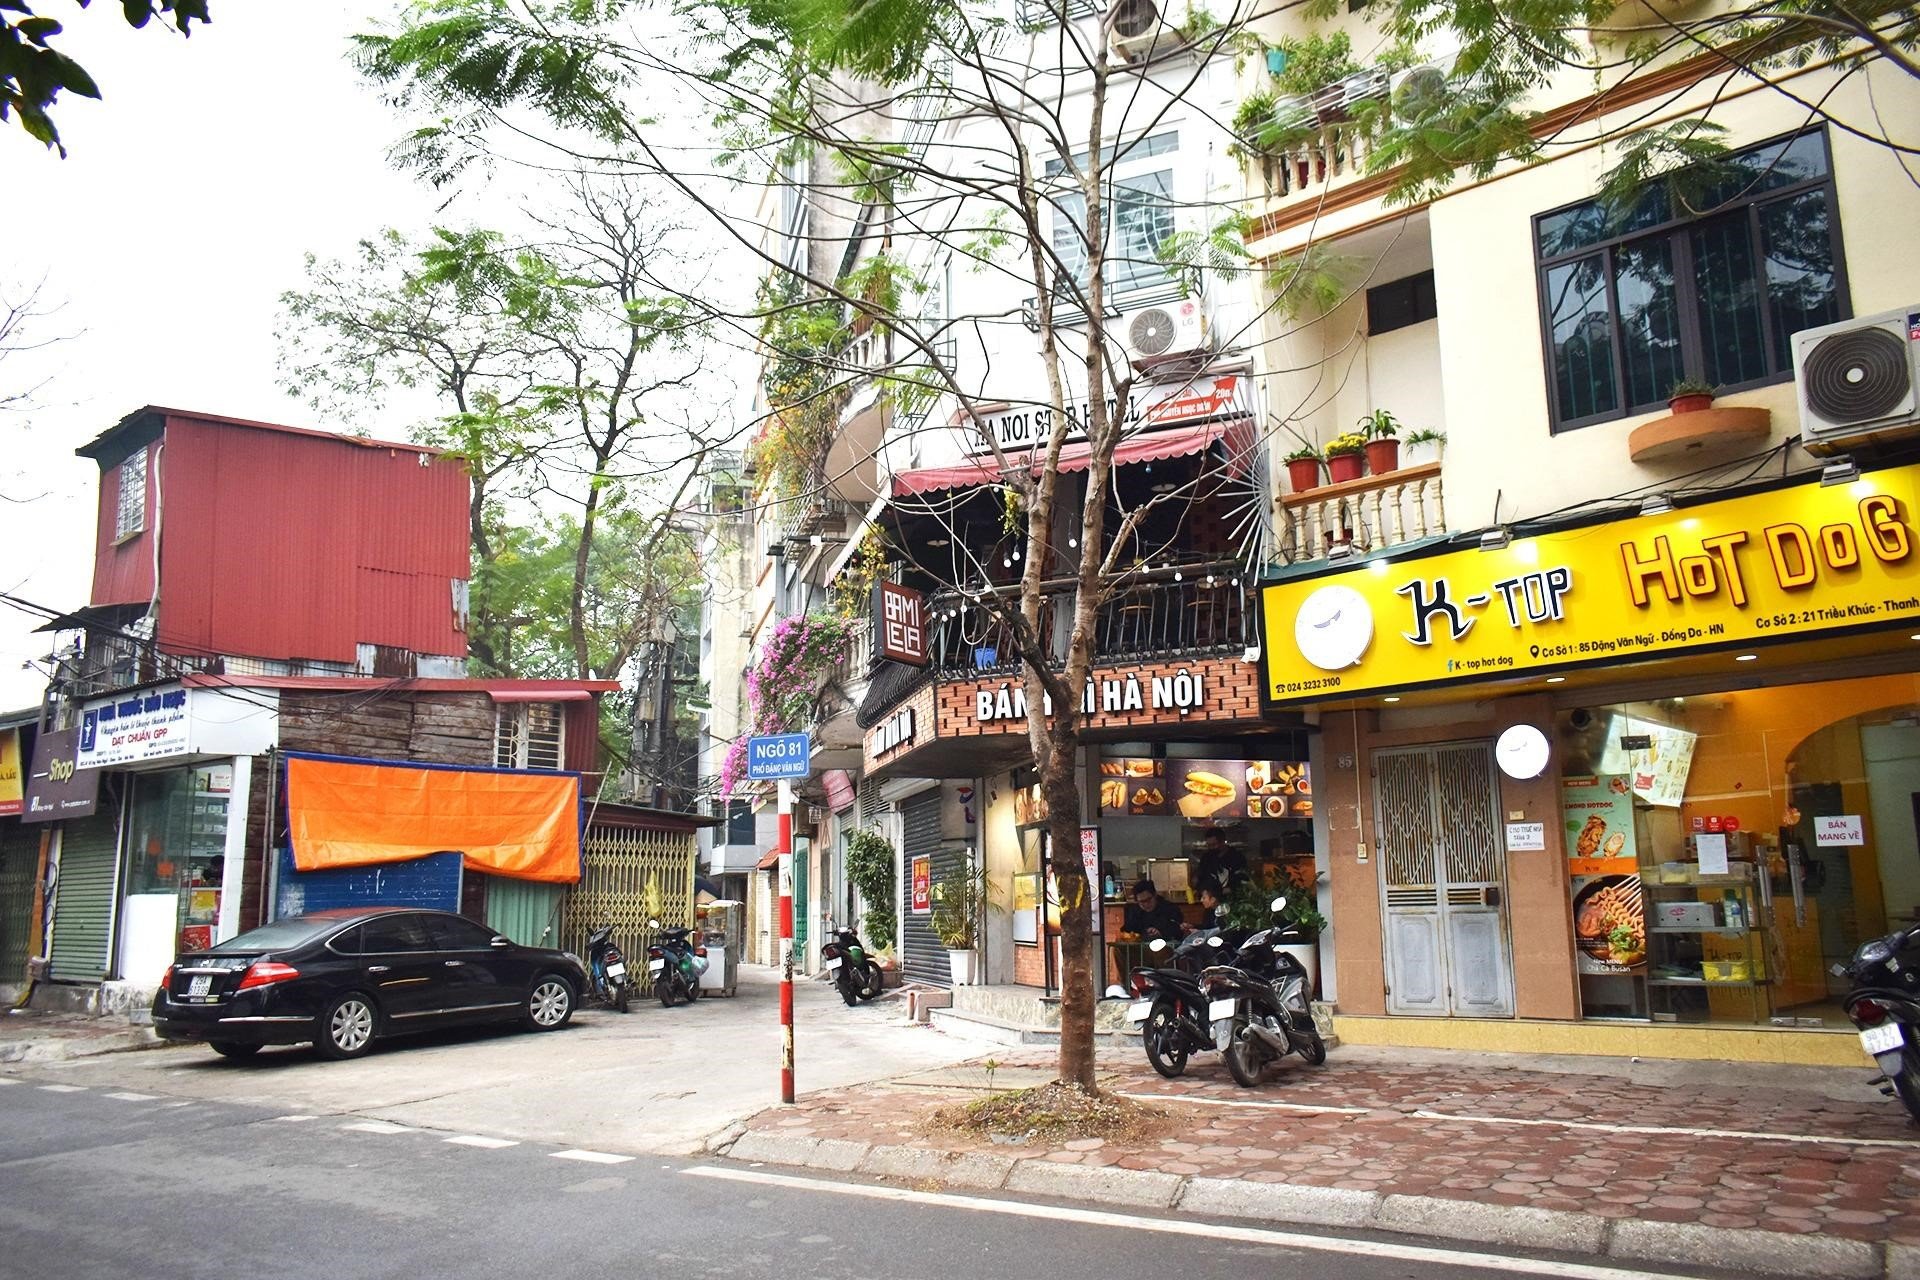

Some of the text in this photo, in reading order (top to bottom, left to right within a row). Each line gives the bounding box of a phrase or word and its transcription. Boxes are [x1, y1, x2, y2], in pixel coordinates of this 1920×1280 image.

[1182, 318, 1194, 327] LG
[1001, 413, 1030, 443] NOI
[1035, 405, 1078, 437] STR
[1789, 613, 1796, 625] 2
[1802, 611, 1816, 623] 21
[1848, 602, 1876, 617] Khúc
[1883, 597, 1920, 612] Thanh
[1579, 642, 1590, 653] 85
[1616, 636, 1634, 648] Văn
[1709, 624, 1725, 636] HN
[1455, 659, 1462, 670] K
[1467, 657, 1480, 670] top
[1481, 656, 1496, 668] hot
[1497, 655, 1514, 668] dog
[1103, 672, 1144, 713] HÀ
[1151, 667, 1204, 716] NỘI
[1286, 676, 1341, 693] 024 3232 3100
[153, 727, 168, 740] GPP
[756, 739, 801, 759] NGÕ 81
[48, 757, 74, 784] Shop
[752, 761, 765, 774] PHỐ
[1828, 819, 1847, 829] BÁN
[1817, 830, 1860, 841] MANG VỀ
[1611, 964, 1631, 973] Busan
